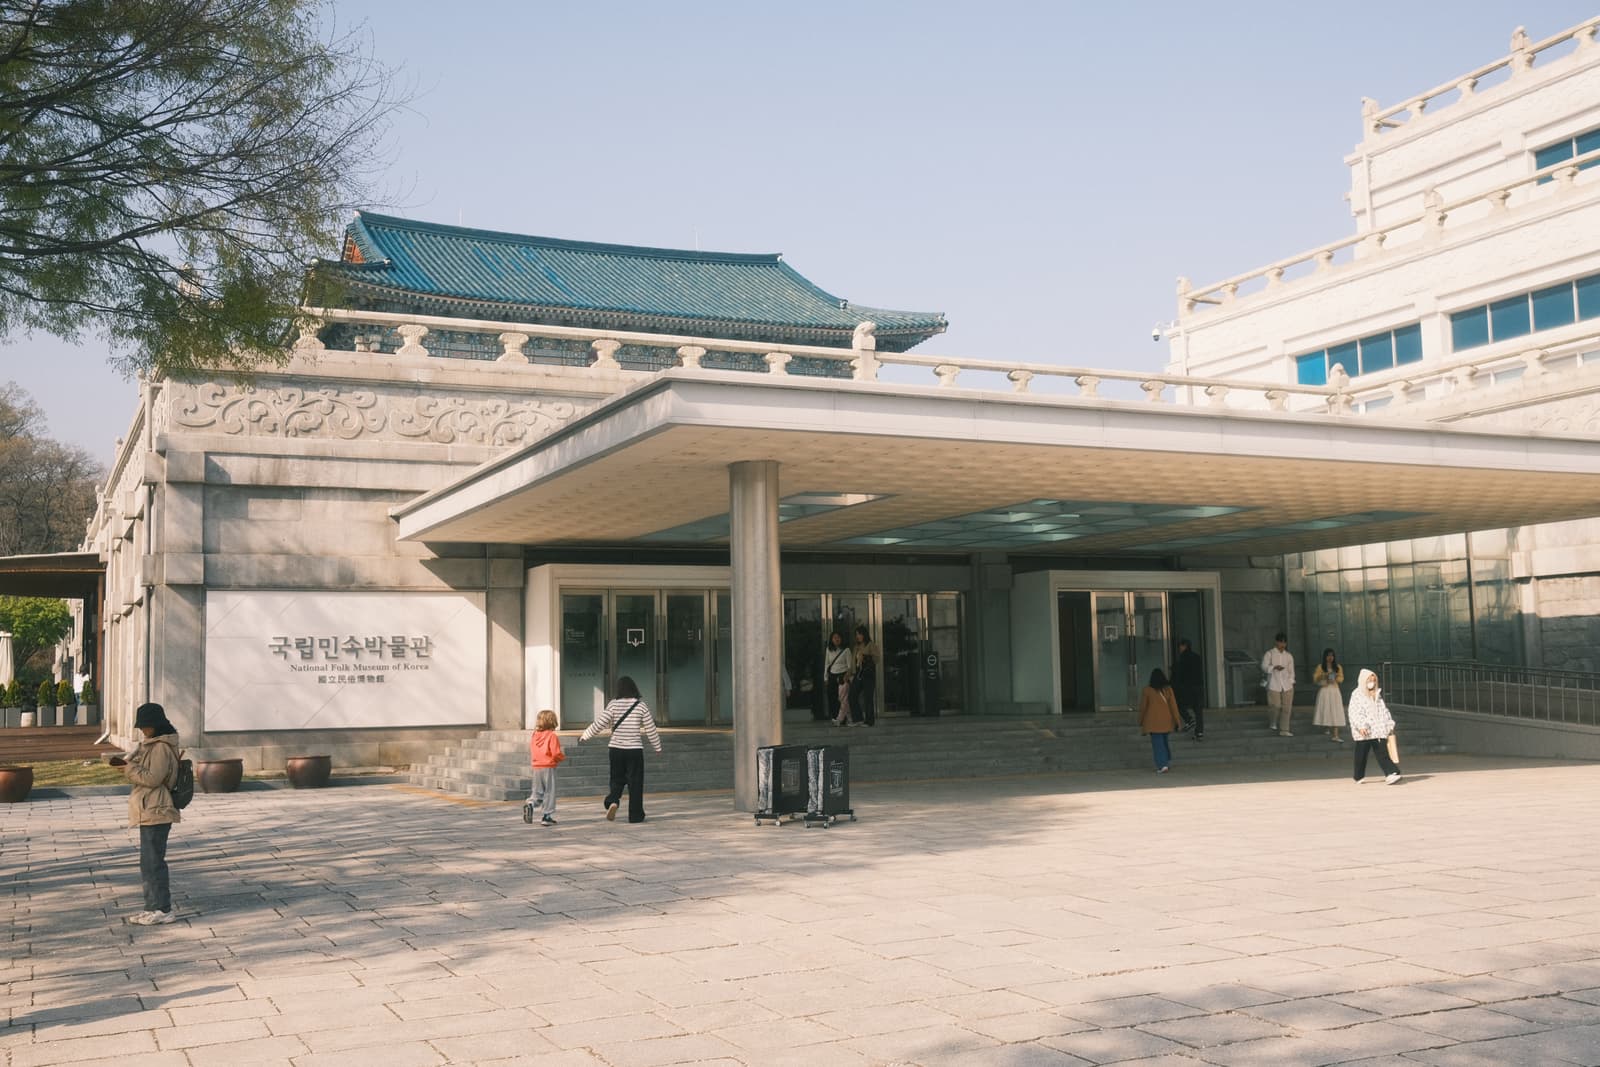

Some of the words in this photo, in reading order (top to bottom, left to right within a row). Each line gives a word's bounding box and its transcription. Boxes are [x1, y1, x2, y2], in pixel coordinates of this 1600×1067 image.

[268, 635, 433, 660] 국립민속박물관
[290, 664, 328, 672] National
[331, 664, 350, 672] Folk
[353, 664, 390, 672] Museum
[392, 663, 401, 671] of
